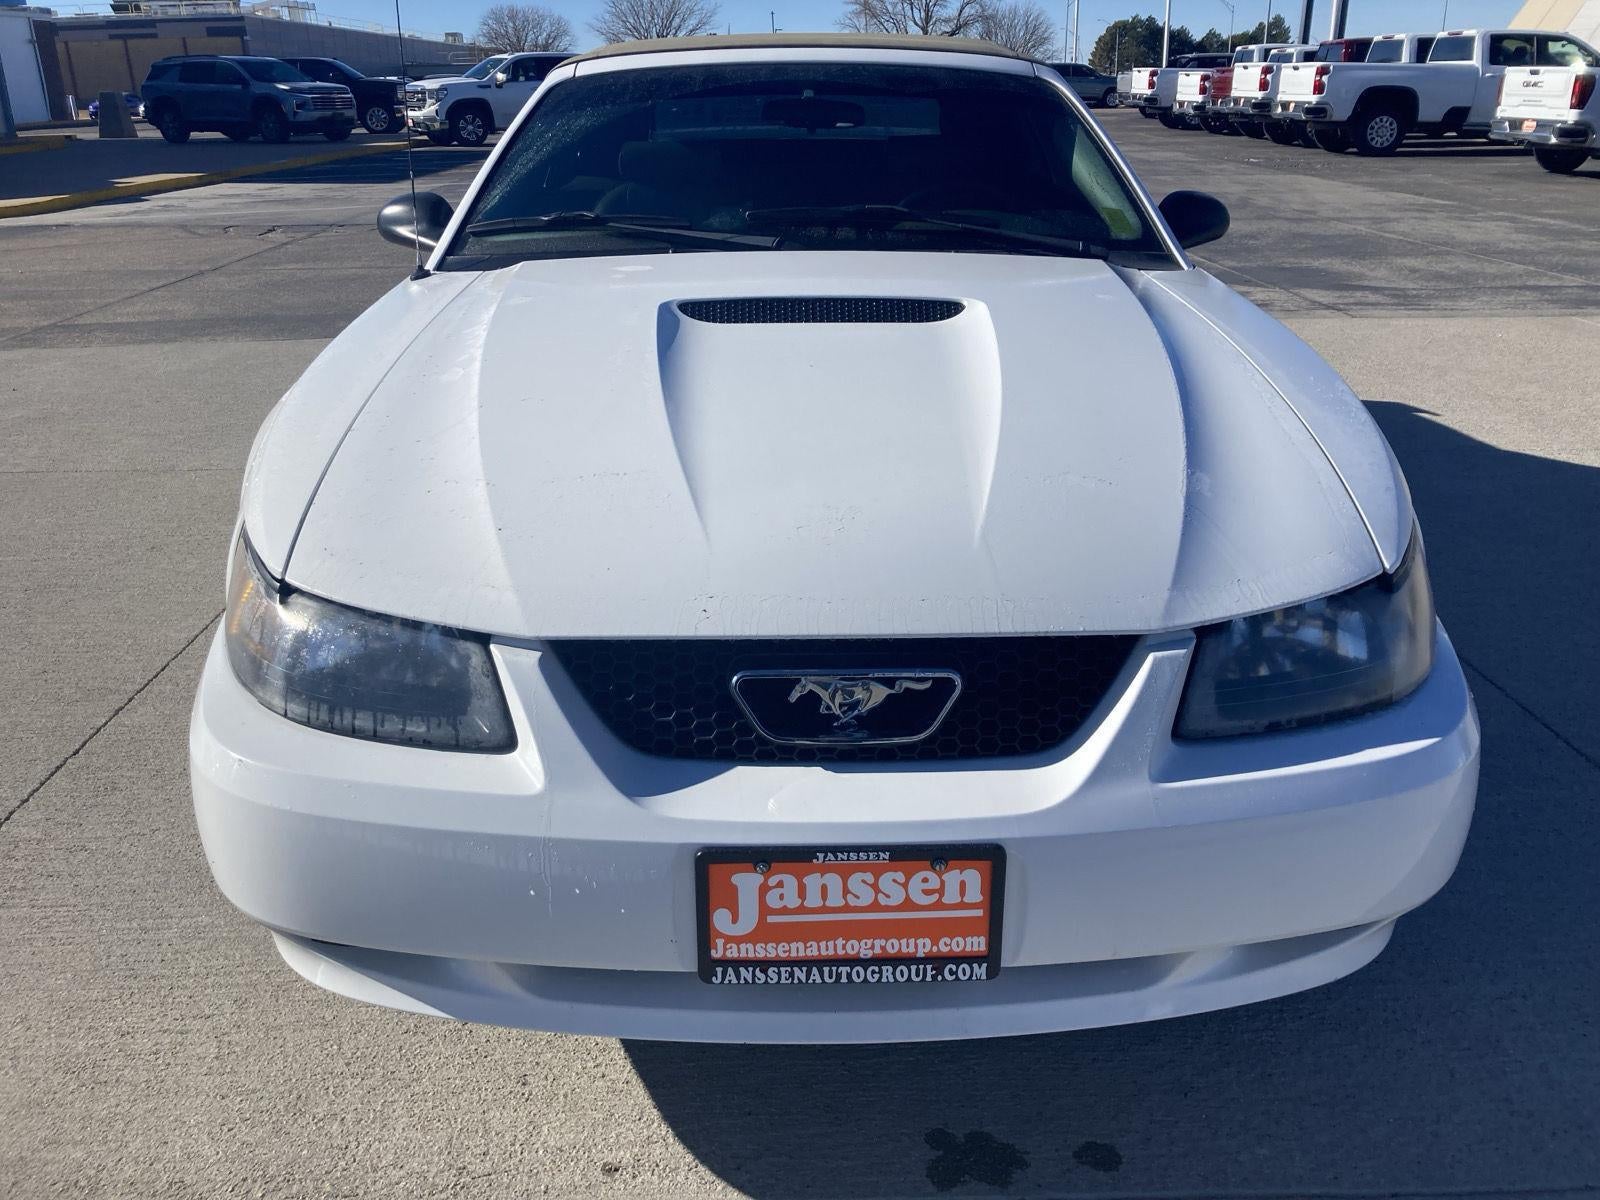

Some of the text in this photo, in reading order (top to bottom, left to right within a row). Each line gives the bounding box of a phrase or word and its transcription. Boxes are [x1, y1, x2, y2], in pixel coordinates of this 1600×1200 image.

[1522, 80, 1543, 88] GMC
[813, 852, 890, 863] JANSSEN
[713, 869, 983, 936] Janssen
[711, 935, 987, 959] Janssenautogroup.com
